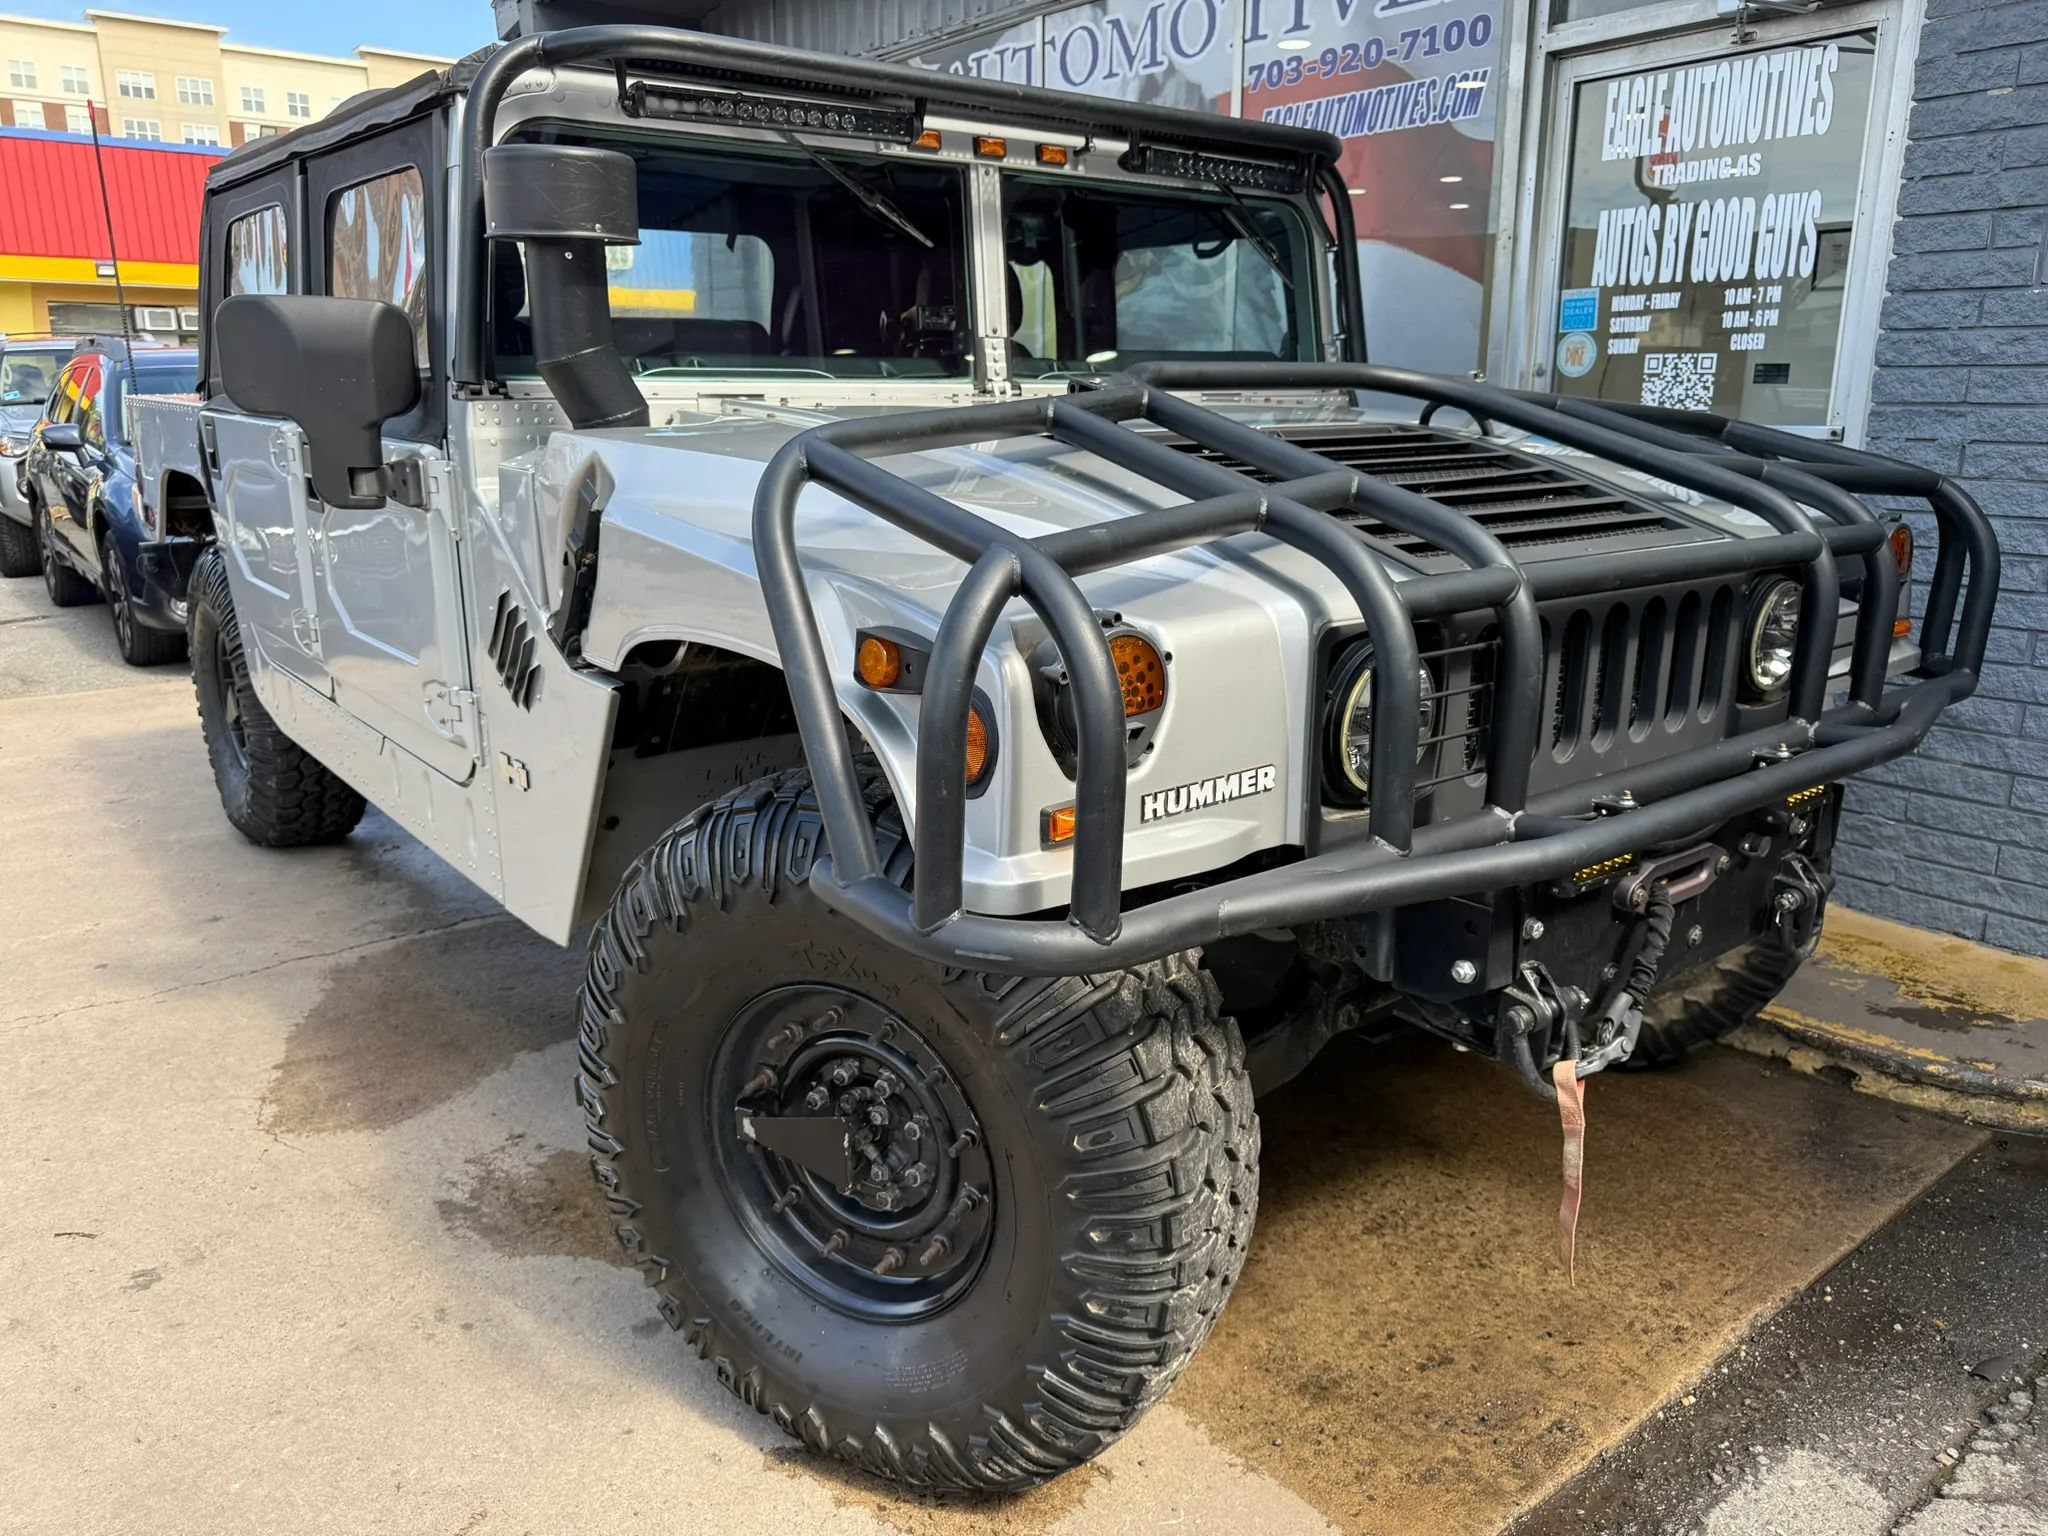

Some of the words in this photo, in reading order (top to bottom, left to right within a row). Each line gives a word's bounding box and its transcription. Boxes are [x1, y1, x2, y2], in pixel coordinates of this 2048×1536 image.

[951, 0, 1440, 87] TOMOTI
[1249, 13, 1493, 92] 703-920-7100
[1262, 68, 1490, 138] GLEAUTOMOTIVES.COM
[1602, 72, 1669, 161] EAGLE
[1665, 43, 1839, 153] AUTOMOTIVES
[1652, 157, 1732, 186] TRADING
[1737, 153, 1762, 177] AS
[1591, 205, 1661, 287] AUTOS
[1659, 202, 1694, 284] BY
[1691, 196, 1756, 284] GOOD
[1755, 189, 1822, 281] GUYS
[1611, 294, 1647, 312] MONDAY
[1650, 292, 1682, 310] FRIDAY
[1757, 286, 1765, 304] 7
[1765, 285, 1783, 304] PM
[1564, 307, 1594, 316] DEALER
[1609, 315, 1653, 334] SATURDAY
[1762, 308, 1779, 327] PM
[1607, 337, 1640, 356] SUNDAY
[1729, 333, 1766, 351] CLOSED
[1140, 763, 1277, 824] HUMMER
